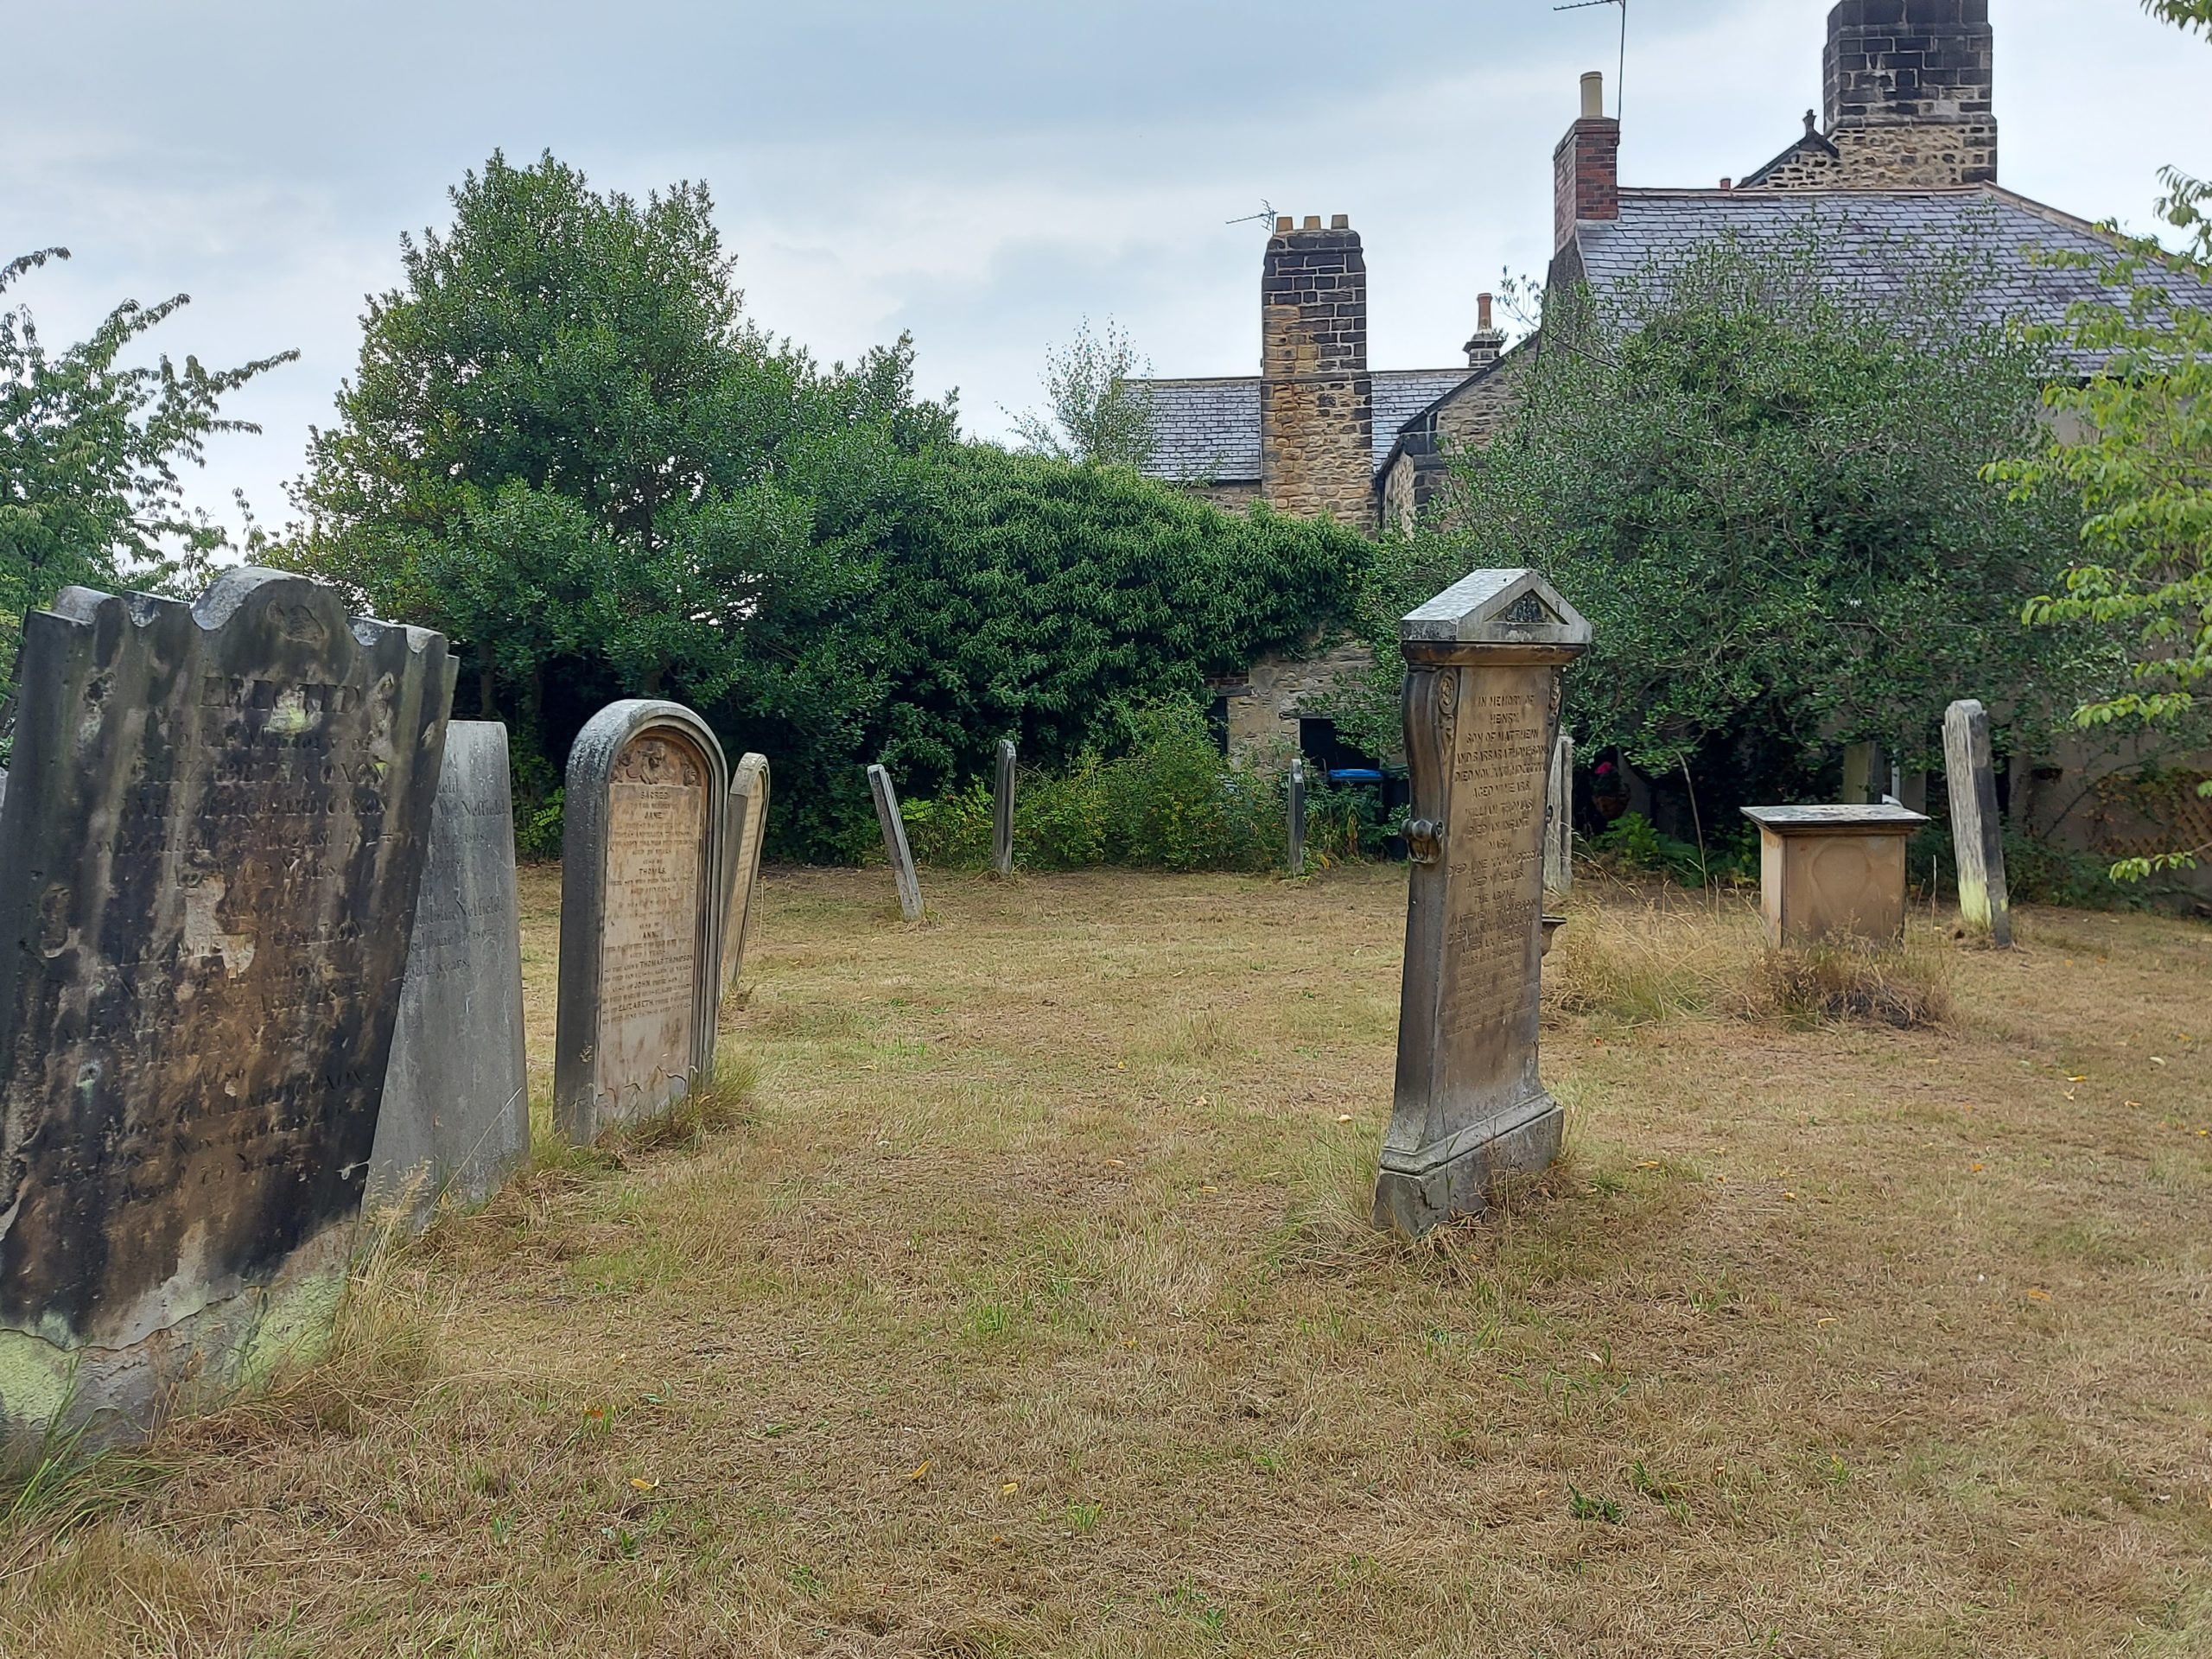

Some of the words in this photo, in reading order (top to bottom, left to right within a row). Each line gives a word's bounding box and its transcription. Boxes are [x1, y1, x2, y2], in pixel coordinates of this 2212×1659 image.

[1478, 696, 1487, 708] IN
[1466, 731, 1484, 744] SON
[1485, 731, 1497, 743] OF
[1497, 728, 1539, 742] MATTHEW
